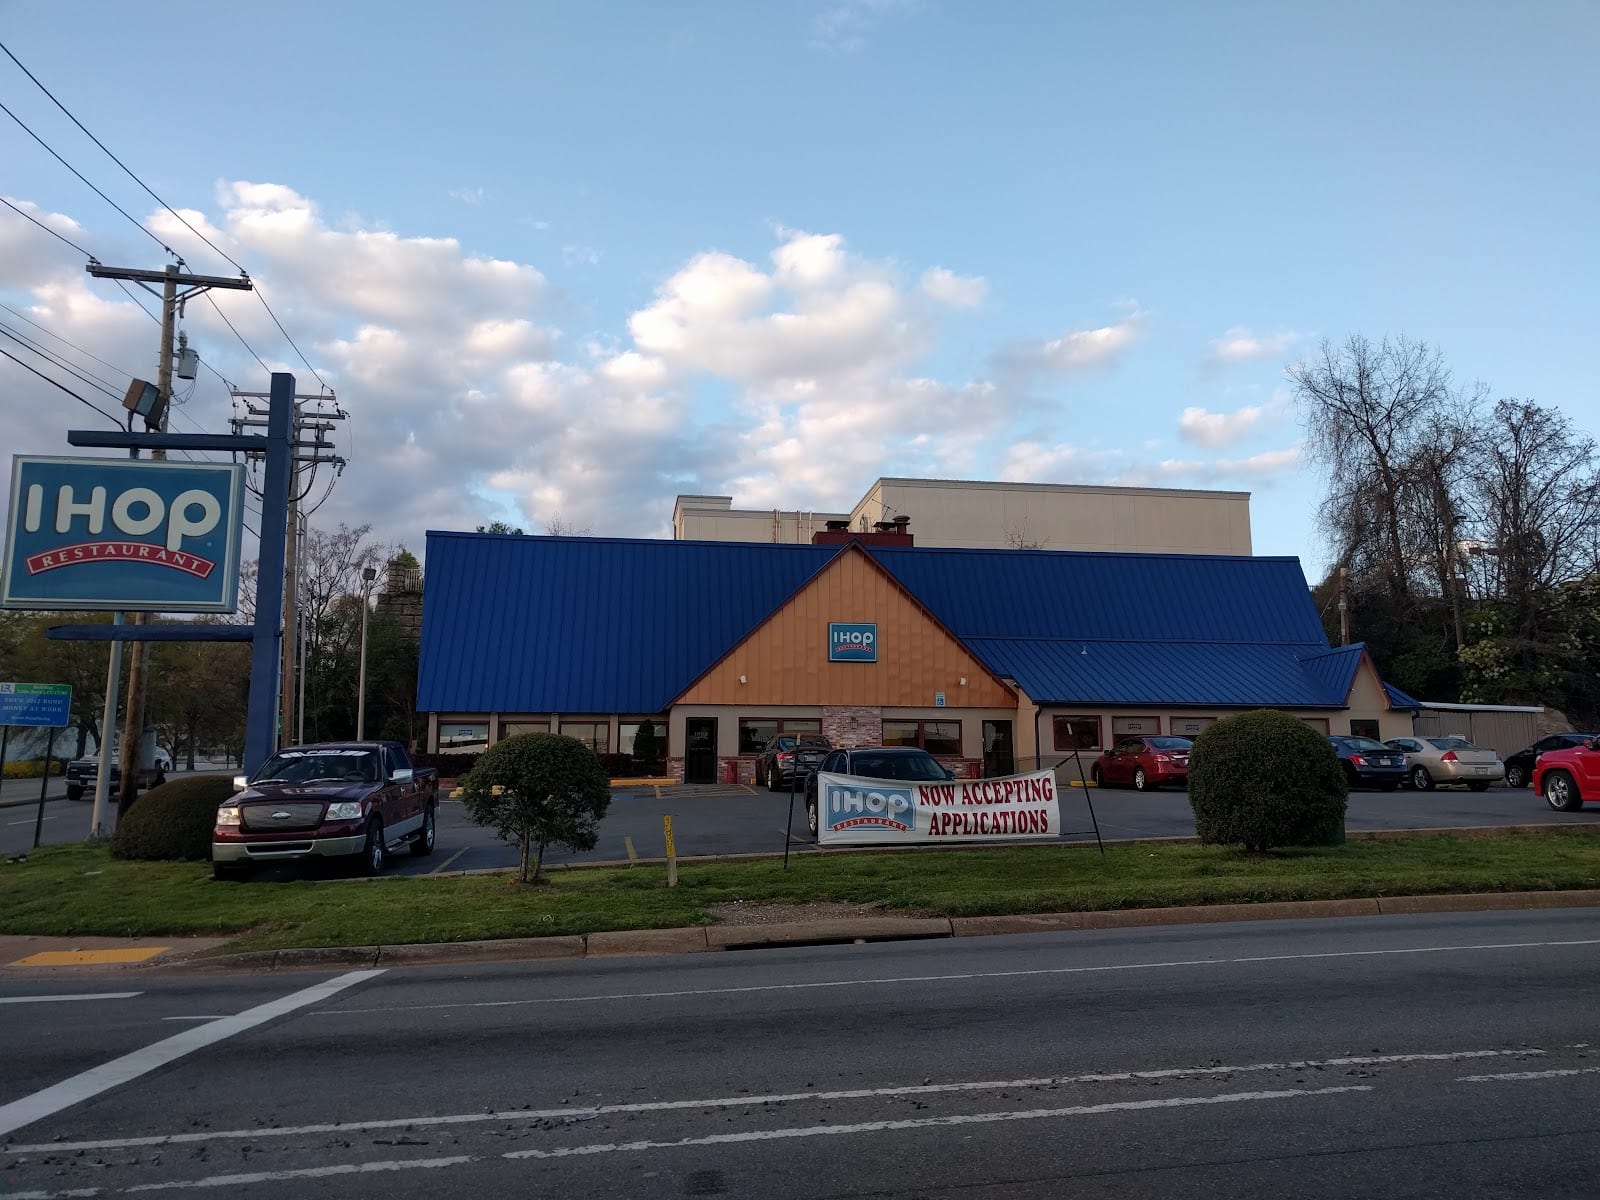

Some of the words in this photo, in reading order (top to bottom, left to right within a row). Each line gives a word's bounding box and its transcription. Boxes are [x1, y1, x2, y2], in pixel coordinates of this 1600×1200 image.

[25, 483, 221, 552] IHOP
[42, 545, 202, 570] RESTAURANT
[834, 632, 874, 646] IHOP
[832, 790, 908, 819] IHOP
[918, 785, 955, 806] NOW
[961, 777, 1053, 805] ACCEPTING
[836, 819, 904, 830] RESTAURANT
[928, 809, 1048, 835] APPLICATIONS
